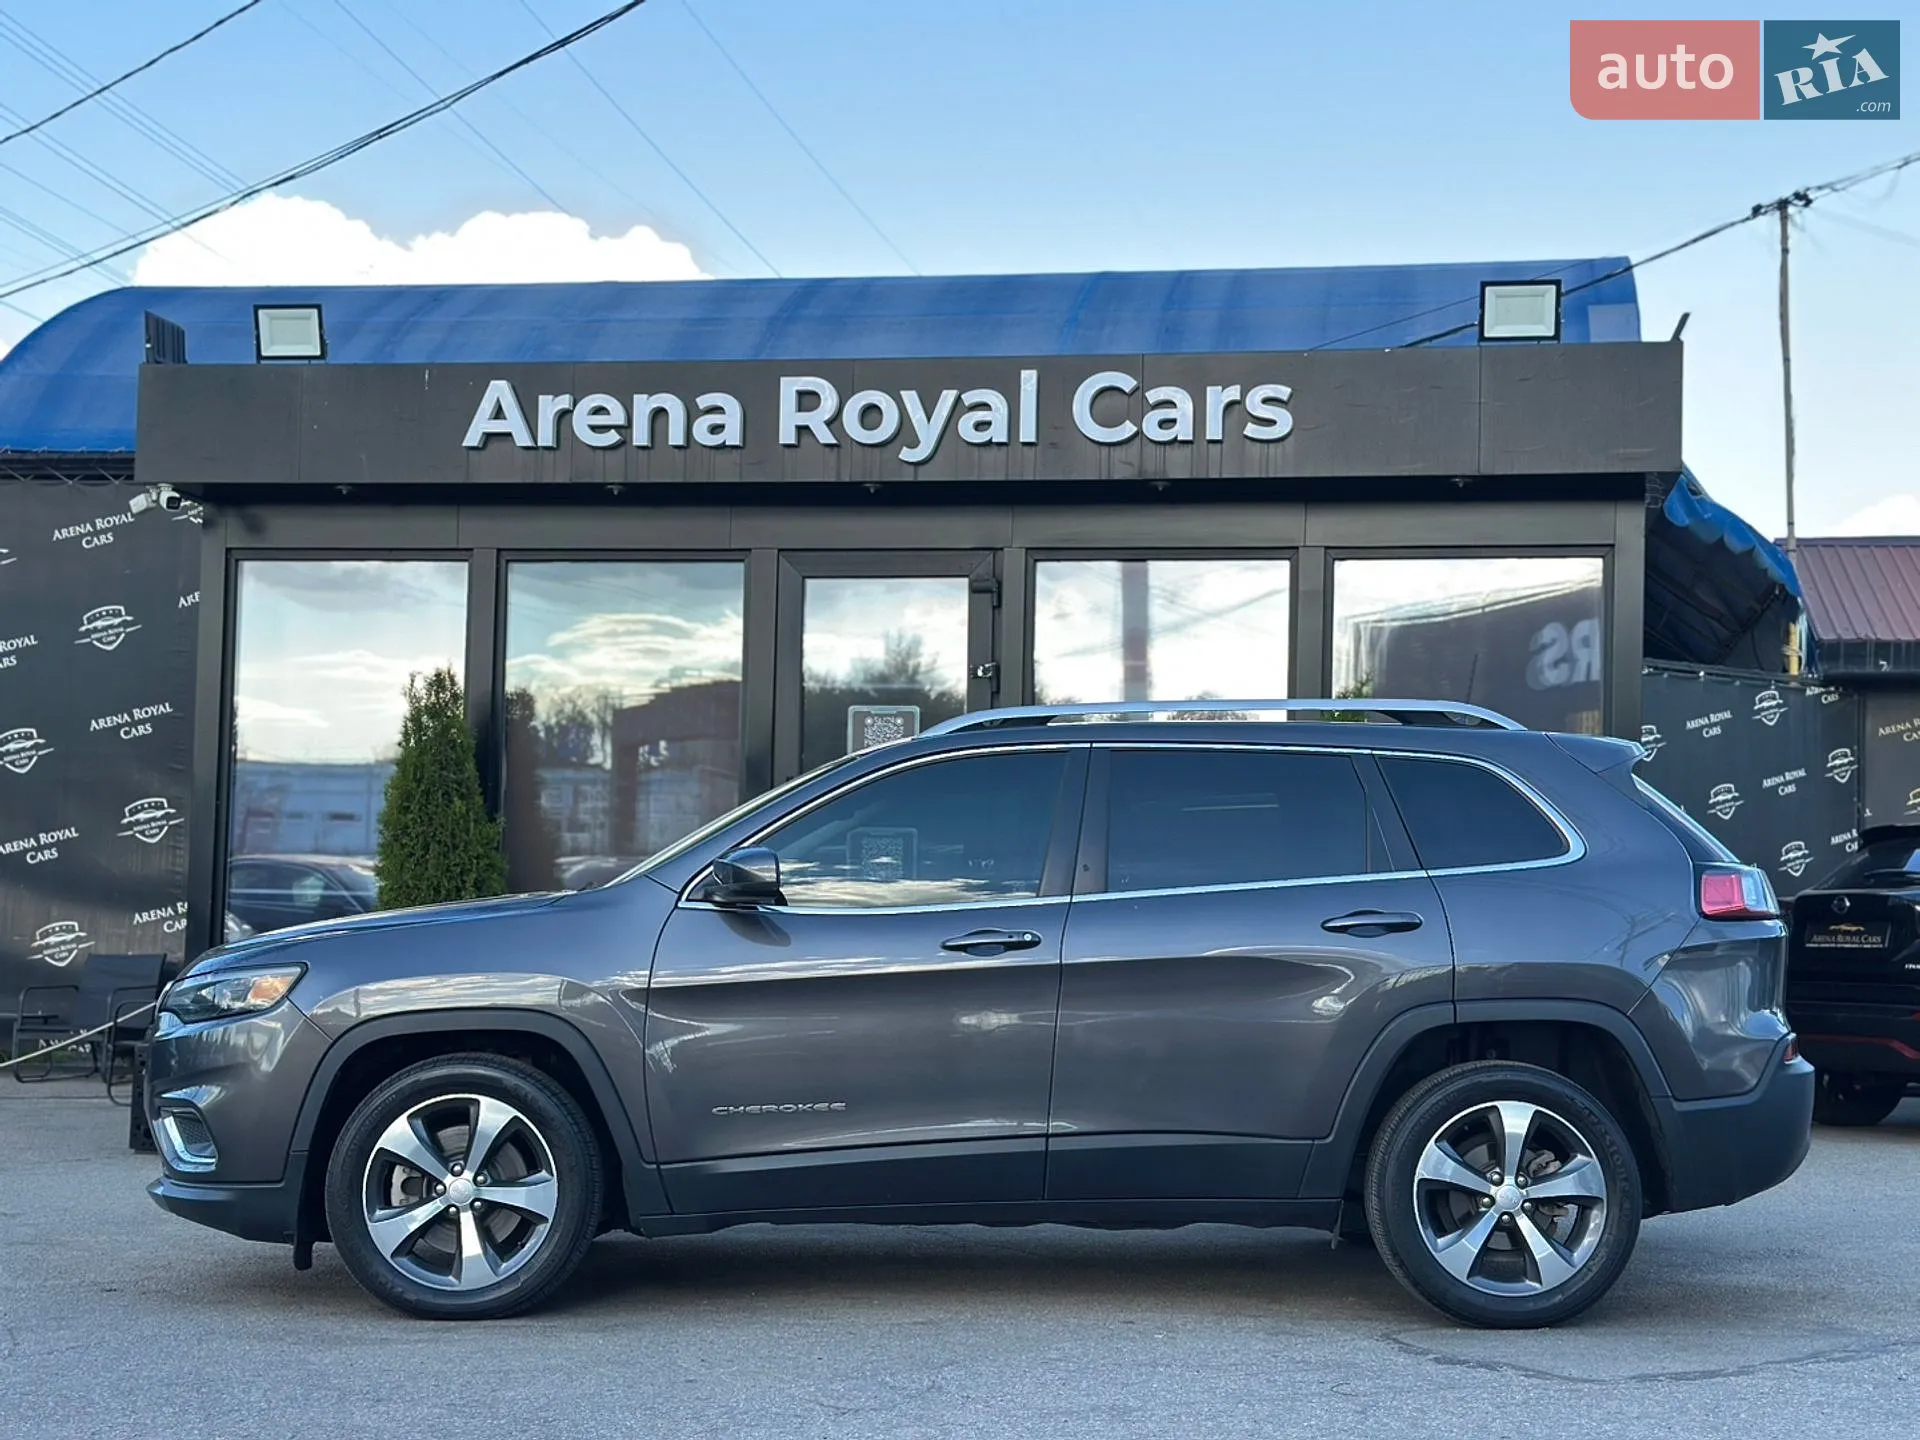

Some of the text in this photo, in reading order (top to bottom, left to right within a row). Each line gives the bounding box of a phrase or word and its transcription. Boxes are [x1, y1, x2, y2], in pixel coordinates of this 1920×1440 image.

[462, 369, 1294, 464] Arena Royal Cars
[52, 512, 135, 542] ARENA ROYAL
[81, 532, 114, 549] CARS
[90, 702, 174, 732] ARENA ROYAL
[1685, 709, 1733, 730] ARENA ROYAL
[120, 722, 153, 740] CARS
[1702, 725, 1722, 738] CARS
[1878, 719, 1912, 737] ARENA
[1762, 774, 1785, 789] ARENA
[1778, 783, 1797, 796] CARS
[38, 827, 80, 845] ROYAL
[26, 847, 59, 864] CARS
[133, 905, 176, 925] ARENA
[711, 1102, 847, 1115] CHEROKEE
